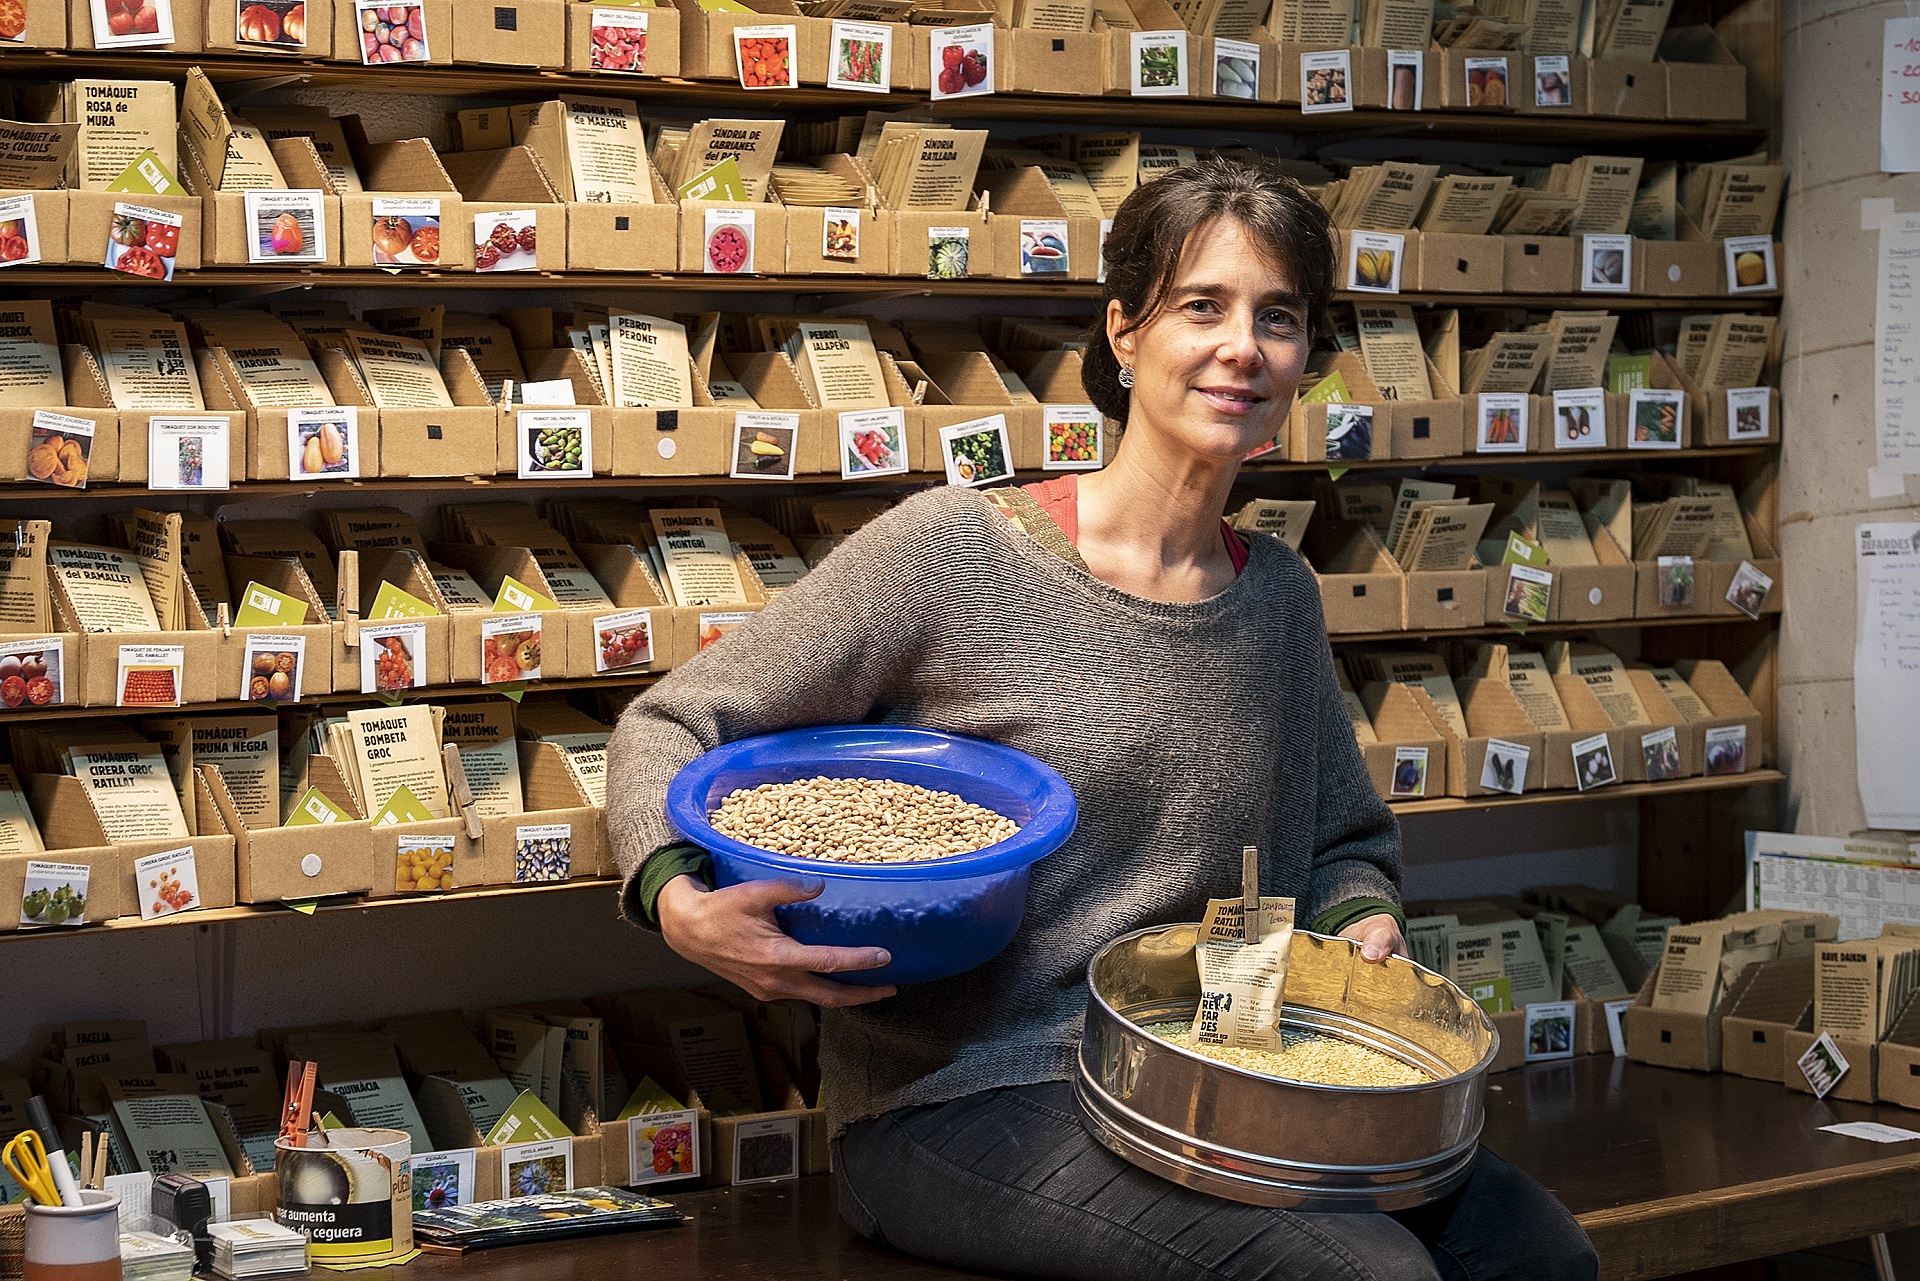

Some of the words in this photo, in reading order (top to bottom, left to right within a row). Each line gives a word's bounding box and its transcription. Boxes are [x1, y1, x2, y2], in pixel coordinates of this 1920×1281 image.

[921, 16, 955, 24] PEBROT
[85, 85, 138, 98] TOMÀQUET
[86, 101, 112, 112] ROSA
[115, 101, 128, 112] de
[571, 102, 606, 116] SÍNDRIA
[608, 107, 626, 118] MEL
[87, 116, 116, 126] MURA
[574, 116, 585, 126] de
[588, 116, 628, 129] MARESME
[0, 128, 49, 142] TOMÀQUET
[50, 133, 61, 144] de
[240, 132, 253, 140] de
[712, 126, 748, 139] SÍNDRIA
[749, 130, 762, 140] DE
[14, 142, 51, 154] COCIOLS
[709, 140, 756, 152] CABRIANES,
[924, 138, 954, 150] SÍNDRIA
[1106, 138, 1130, 148] BLANCA
[705, 151, 718, 161] del
[920, 151, 958, 162] RATLLADA
[1592, 164, 1610, 175] MELÓ
[618, 316, 652, 332] PEBROT
[619, 330, 658, 345] PERONET
[808, 330, 839, 340] PEBROT
[356, 336, 402, 348] TOMÀQUET
[441, 336, 476, 348] PEBROT
[478, 336, 492, 346] del
[812, 340, 850, 351] JALAPEÑO
[232, 346, 282, 358] TOMÀQUET
[360, 347, 385, 357] VERD
[237, 358, 280, 369] TARONJA
[1260, 508, 1276, 518] CEBA
[1278, 510, 1287, 518] de
[660, 516, 703, 528] TOMÀQUET
[704, 518, 715, 527] de
[1256, 519, 1287, 528] CAMPENY
[1433, 516, 1450, 524] CEBA
[664, 528, 691, 540] penjar
[354, 536, 398, 547] TOMÀQUET
[400, 536, 412, 544] de
[668, 538, 706, 550] MONTGRÍ
[56, 549, 108, 562] TOMÀQUET
[110, 554, 122, 564] de
[774, 552, 784, 560] de
[62, 560, 92, 572] penjar
[94, 563, 120, 573] PETIT
[65, 570, 81, 580] del
[84, 571, 132, 584] RAMALLET
[361, 718, 408, 733] TOMÀQUET
[464, 724, 499, 737] ATÒMIC
[192, 728, 248, 740] TOMÀQUET
[364, 732, 408, 747] BOMBETA
[192, 741, 230, 753] PRUNA
[232, 740, 269, 752] NEGRA
[568, 742, 607, 754] TOMÀQUE
[86, 752, 139, 764] TOMÀQUET
[367, 748, 392, 760] GROC
[574, 754, 604, 765] CIRERA
[90, 765, 126, 776] CIRERA
[128, 764, 152, 776] GROC
[580, 764, 602, 774] GROC
[92, 777, 136, 788] RATLLAT
[172, 850, 191, 860] RATLLAT
[1214, 916, 1245, 926] RATLLAT
[1210, 926, 1245, 938] CALIFÒR
[1821, 952, 1840, 962] RAVE
[1840, 952, 1867, 963] DAIKON
[1202, 1010, 1218, 1022] FAR
[1200, 1022, 1218, 1032] DES
[76, 1032, 112, 1044] FACÈLIA
[75, 1054, 111, 1067] FACÈLIA
[232, 1066, 260, 1077] grana
[118, 1078, 157, 1088] FACÈLIA
[332, 1081, 380, 1094] EQUINÀCIA
[288, 1210, 336, 1222] aumenta
[298, 1224, 310, 1236] de
[313, 1226, 362, 1241] ceguera
